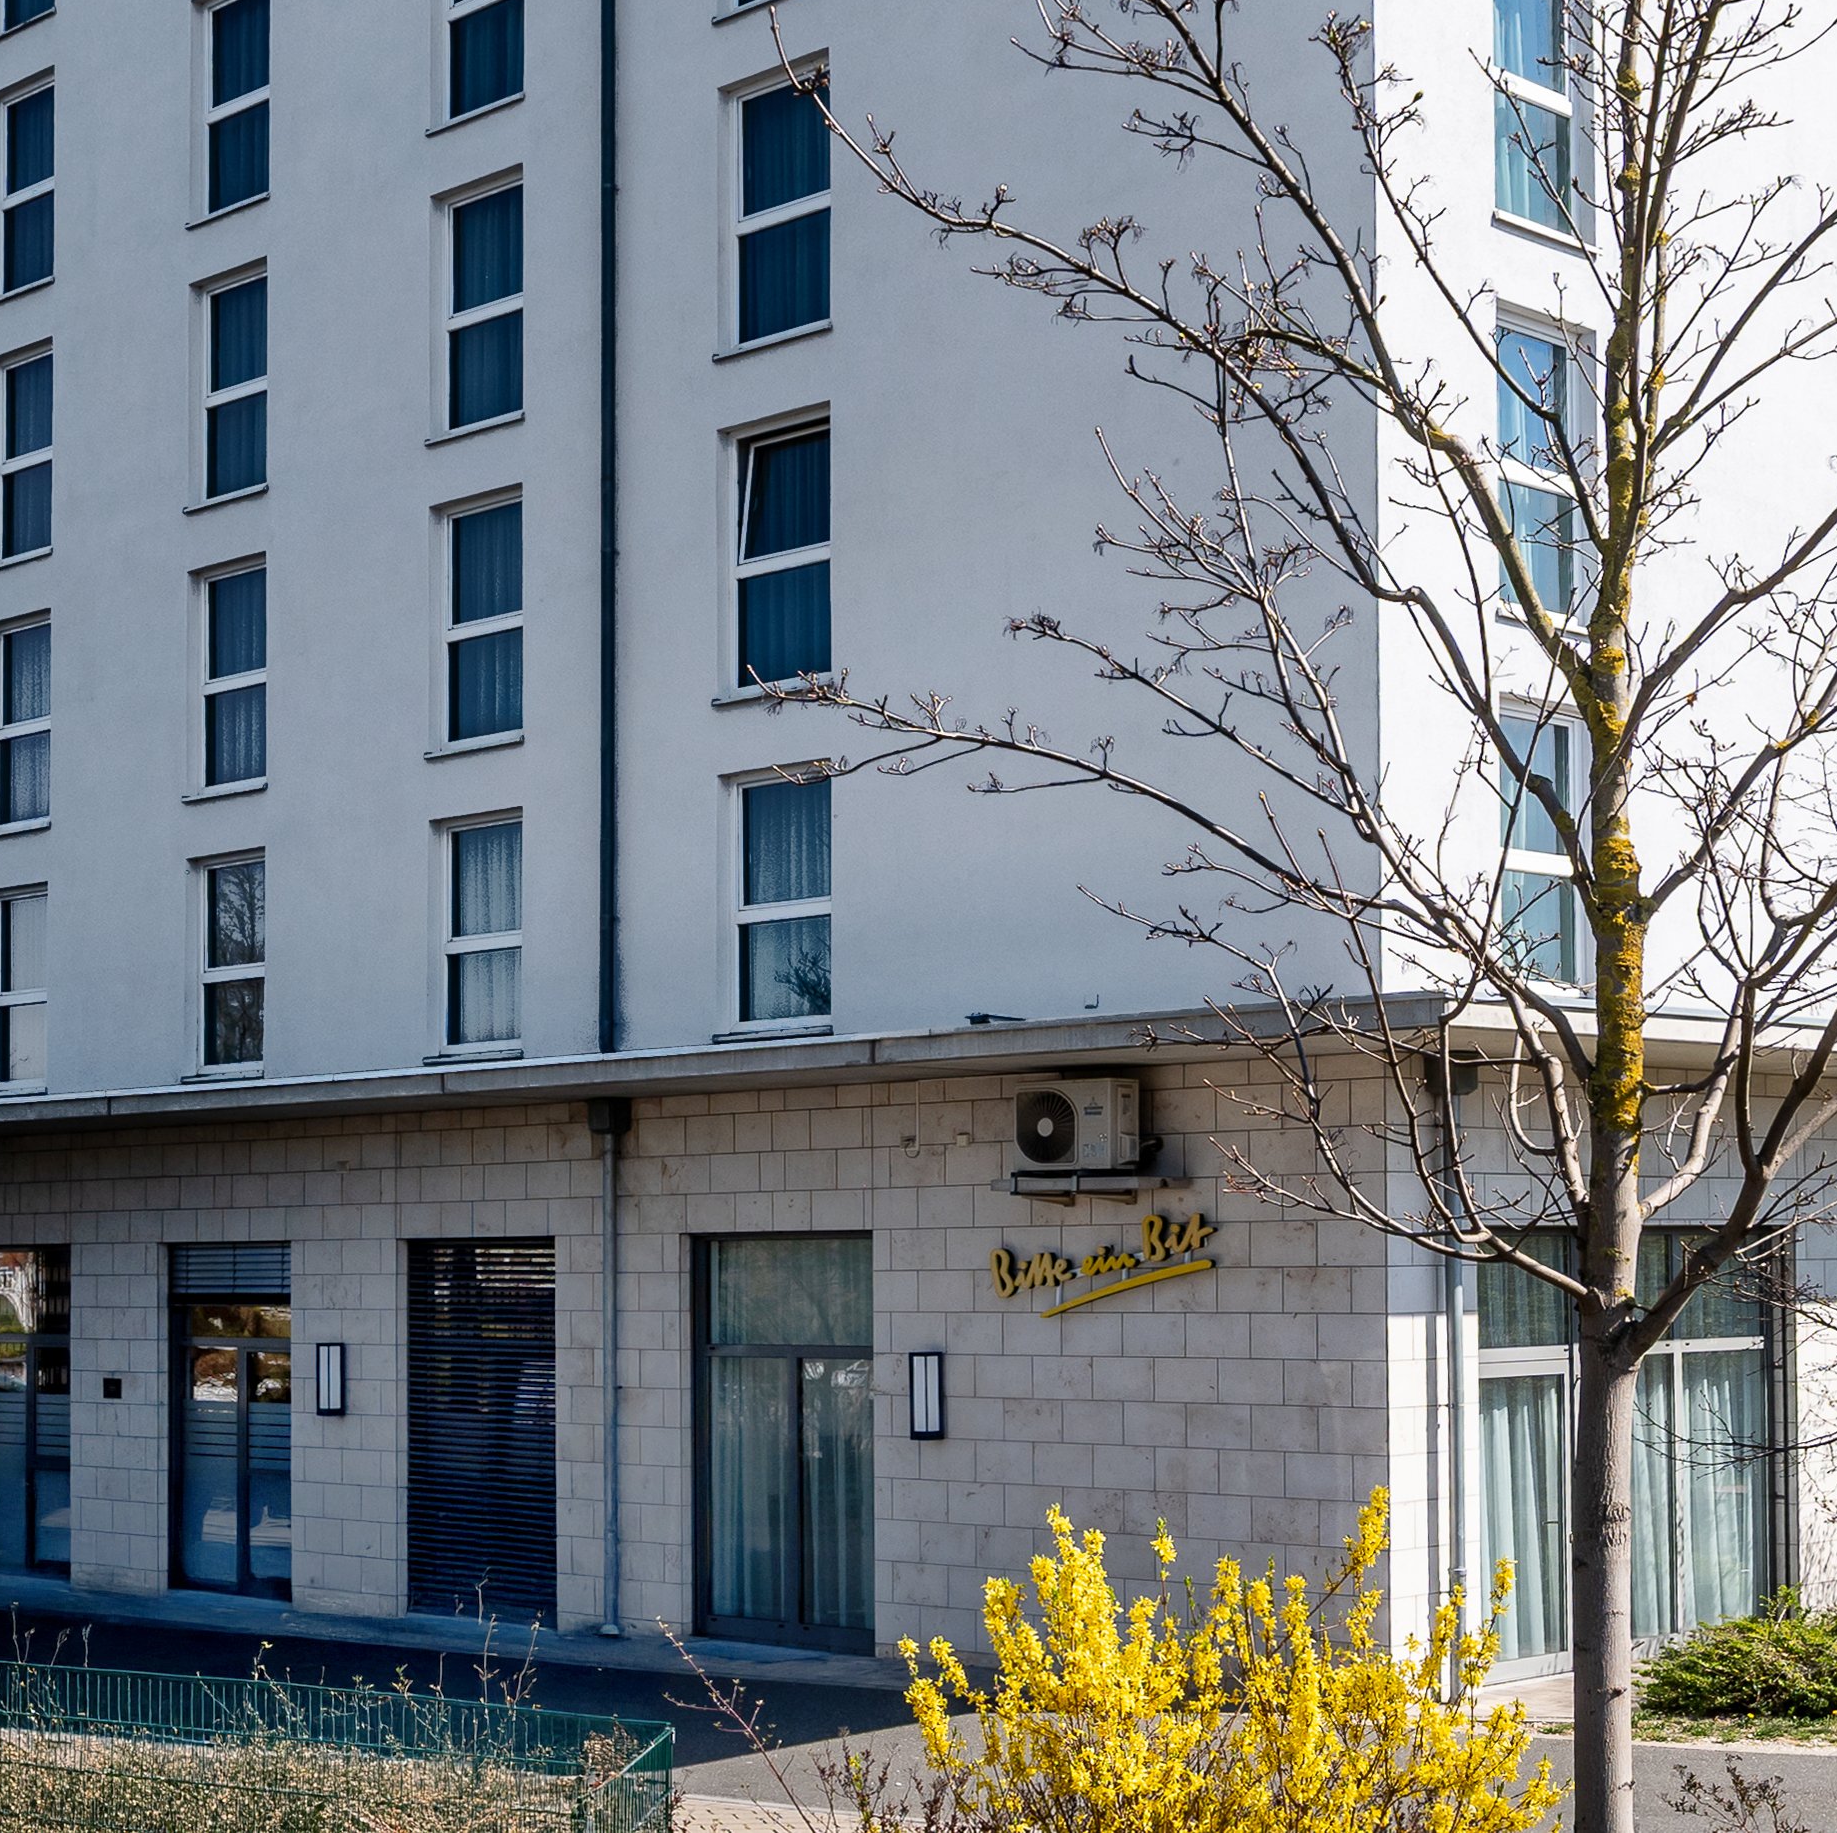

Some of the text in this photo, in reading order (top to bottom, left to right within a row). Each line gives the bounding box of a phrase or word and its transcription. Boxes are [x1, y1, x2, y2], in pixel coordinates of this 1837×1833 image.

[989, 1213, 1215, 1299] Bitte ein Bit
